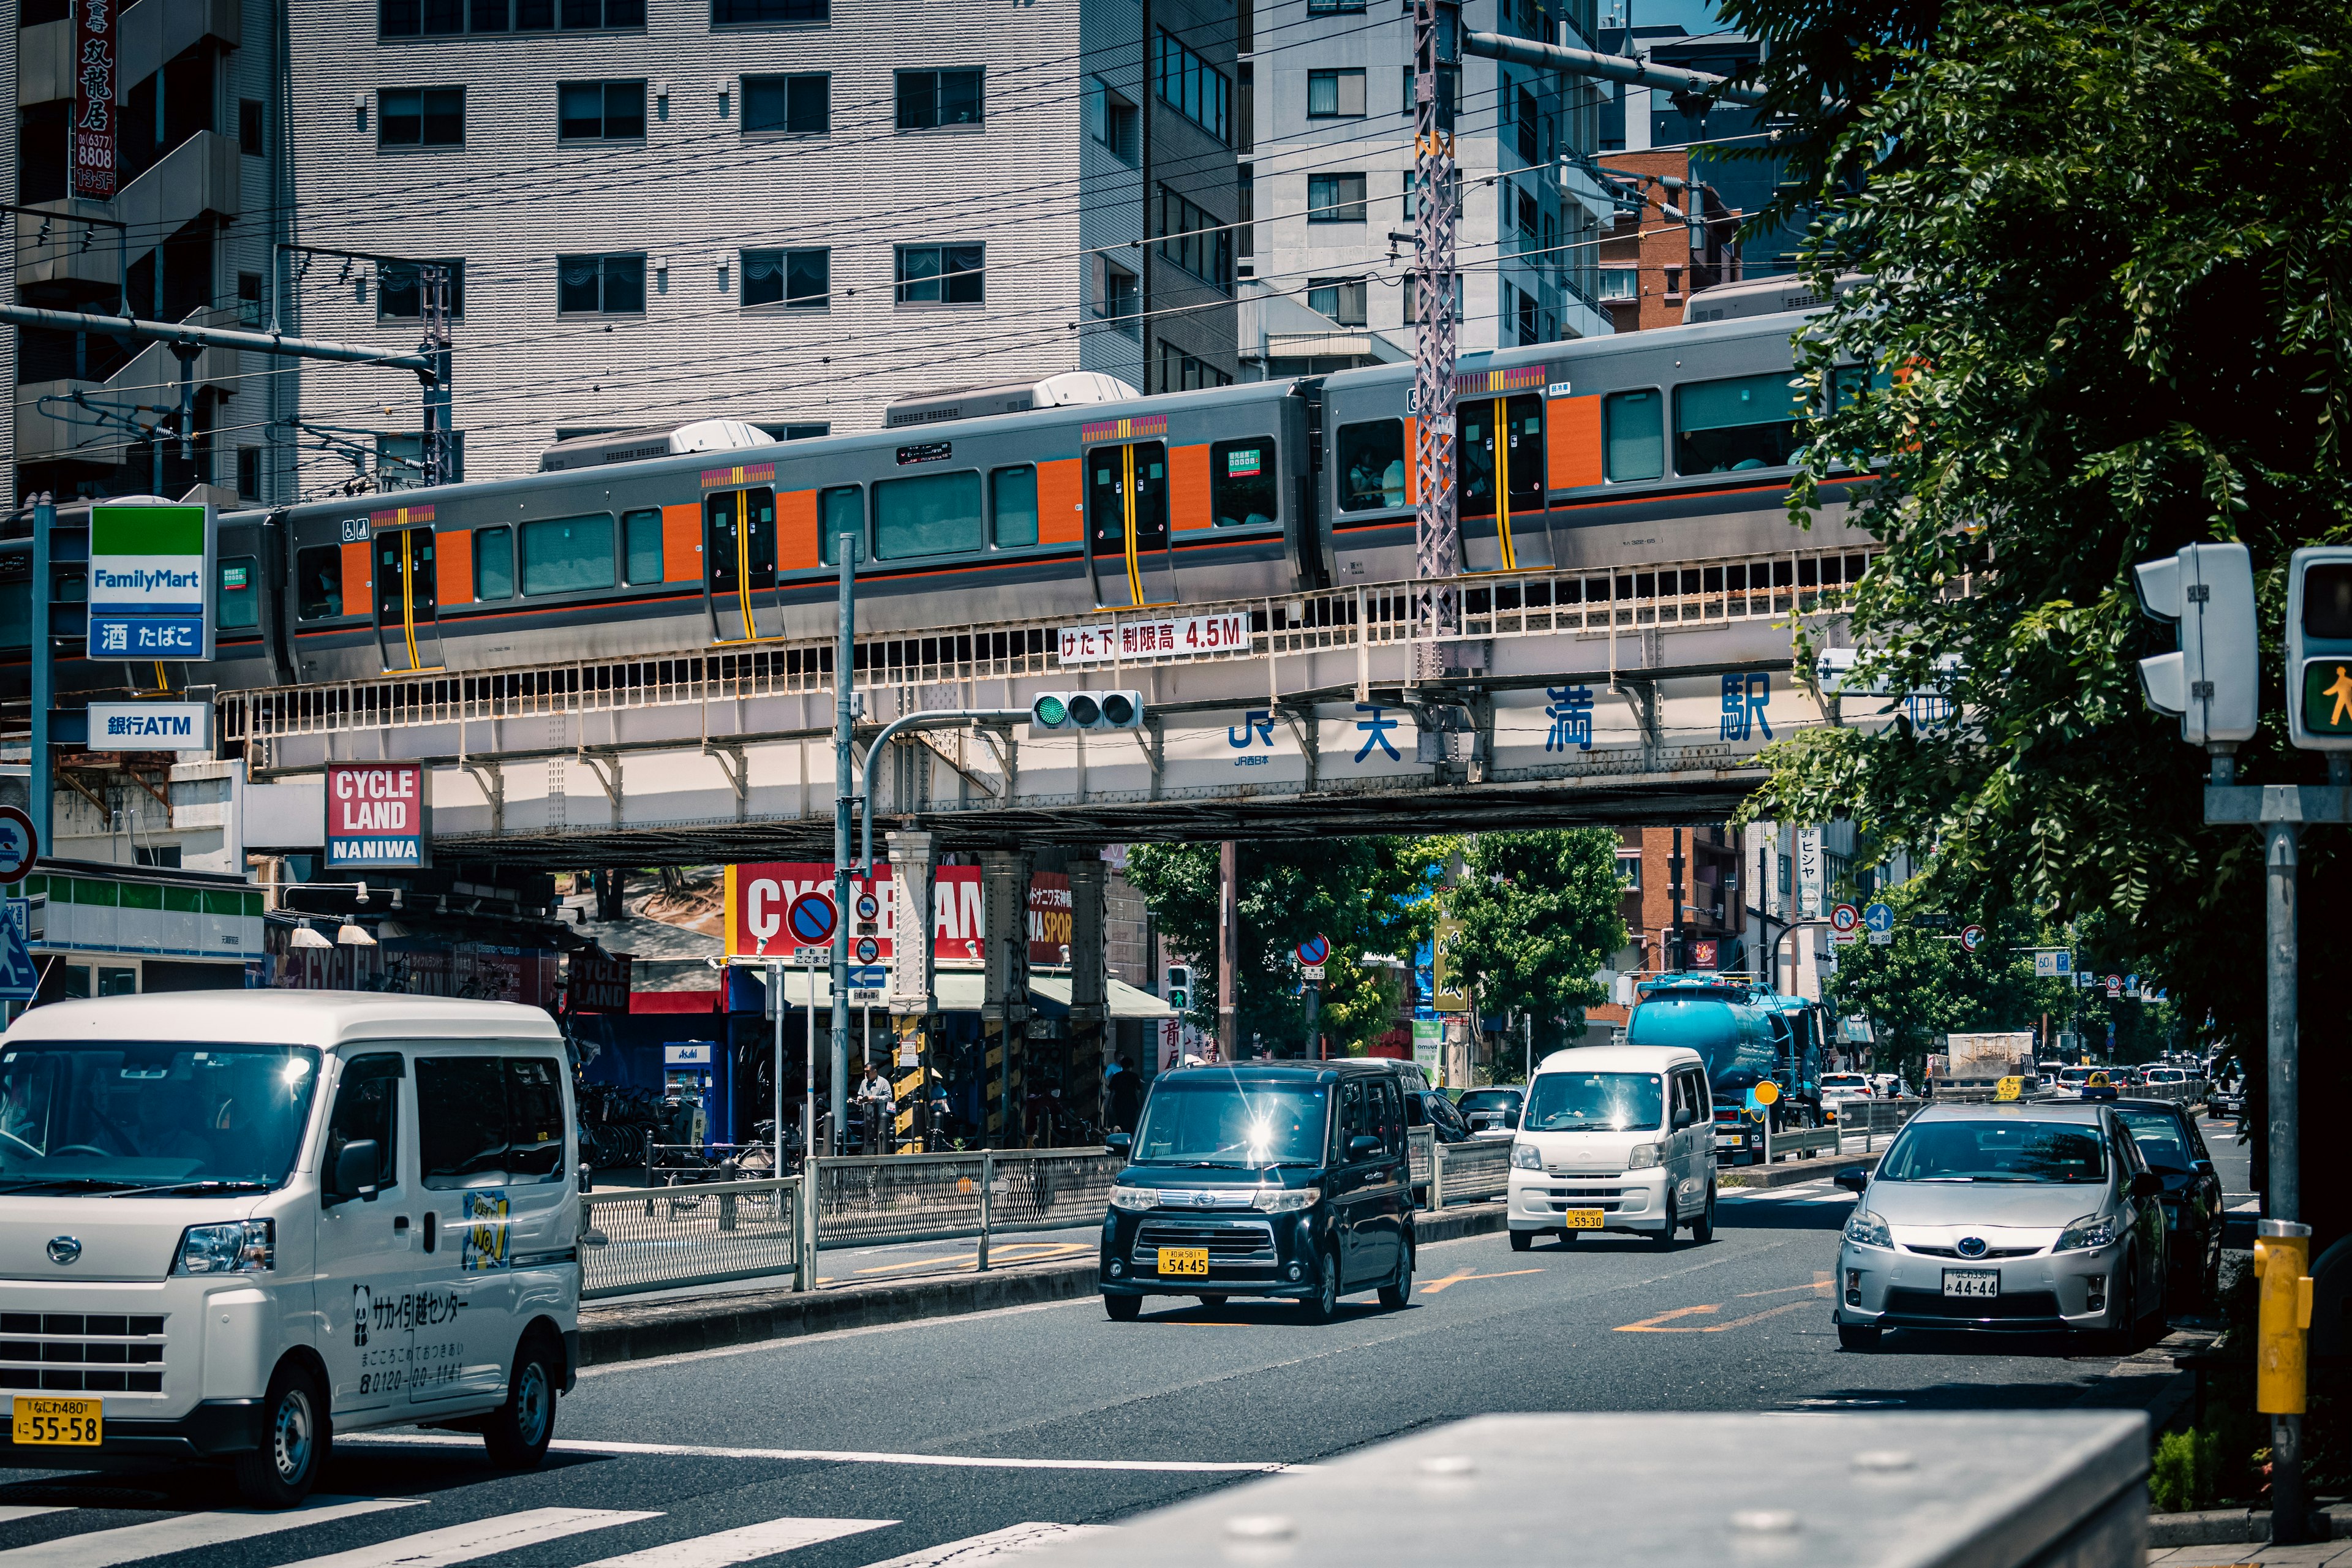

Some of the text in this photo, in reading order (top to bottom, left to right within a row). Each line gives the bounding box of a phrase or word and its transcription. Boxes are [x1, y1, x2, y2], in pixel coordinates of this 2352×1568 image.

[86, 0, 108, 34] 食府
[80, 38, 112, 130] 双龍居
[79, 145, 111, 168] 8808
[95, 570, 198, 592] FamilyMart
[102, 624, 192, 650] 酒 たばこ
[1186, 617, 1240, 648] 4.5M
[108, 716, 191, 736] 銀行ATM
[1228, 710, 1275, 748] JR
[1234, 755, 1269, 766] JR西日本
[336, 770, 413, 799] CYCLE
[344, 801, 406, 829] LAND
[333, 840, 418, 859] NANIWA
[1802, 841, 1814, 878] ヒシヤ
[1044, 911, 1072, 944] SPOR
[796, 956, 829, 964] ここまで
[679, 1049, 697, 1059] Asahi
[1575, 1217, 1601, 1226] 59-30
[1169, 1259, 1205, 1273] 54-45
[1955, 1270, 1987, 1279] なにわ330
[1955, 1280, 1996, 1295] 44-44
[373, 1291, 469, 1330] サカイ引越センター
[362, 1342, 464, 1367] まごころこめておつきあい
[372, 1362, 462, 1393] 0120-00-1141
[34, 1401, 83, 1414] なにわ480
[18, 1416, 97, 1441] に 55-58
